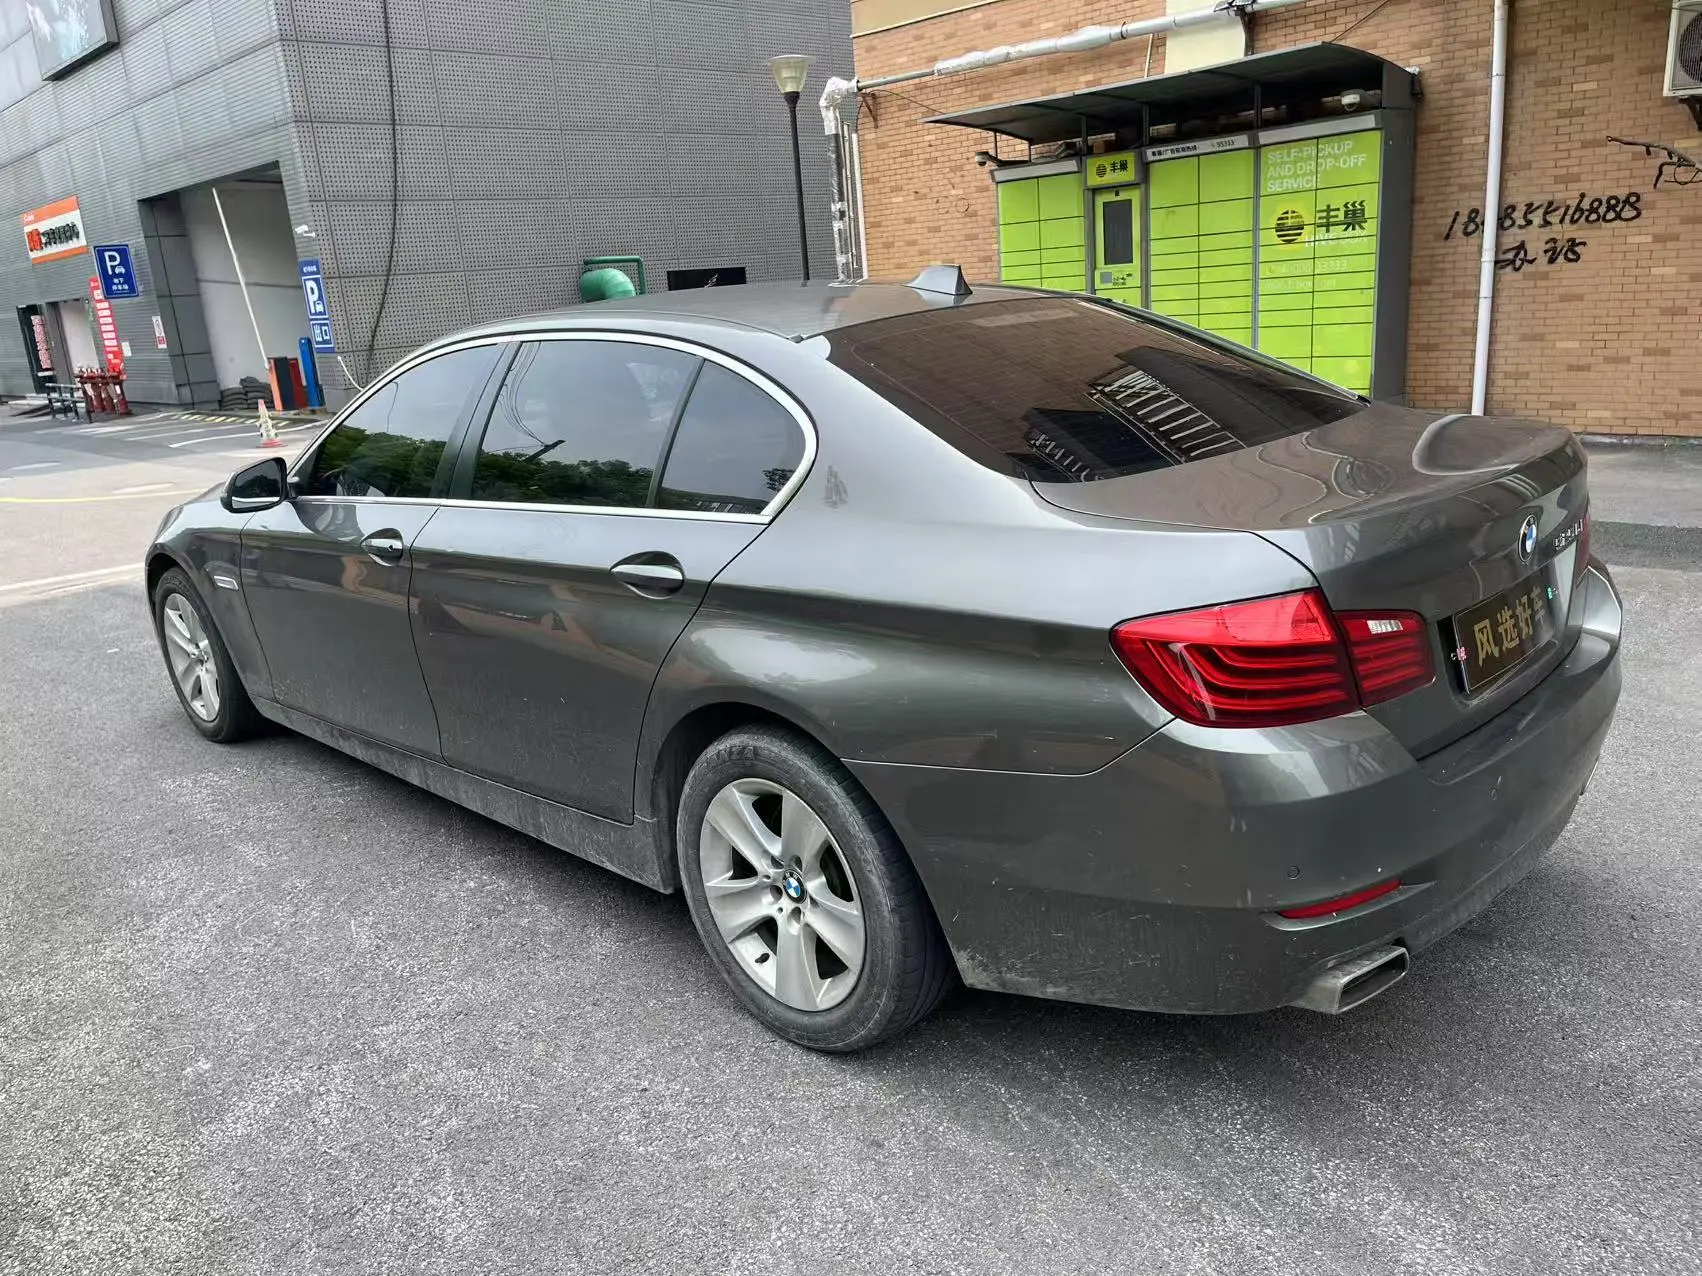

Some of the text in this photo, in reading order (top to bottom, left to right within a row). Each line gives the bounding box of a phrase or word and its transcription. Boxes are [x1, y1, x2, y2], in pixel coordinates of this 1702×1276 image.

[1268, 141, 1353, 163] SELF-PICKUP
[1110, 159, 1129, 174] 丰巢
[1267, 153, 1367, 179] AND DROP-OFF
[1267, 175, 1321, 192] SERVICE
[1316, 200, 1368, 233] 丰巢
[1444, 191, 1642, 241] 1885516888
[104, 251, 121, 275] P
[305, 280, 318, 314] P
